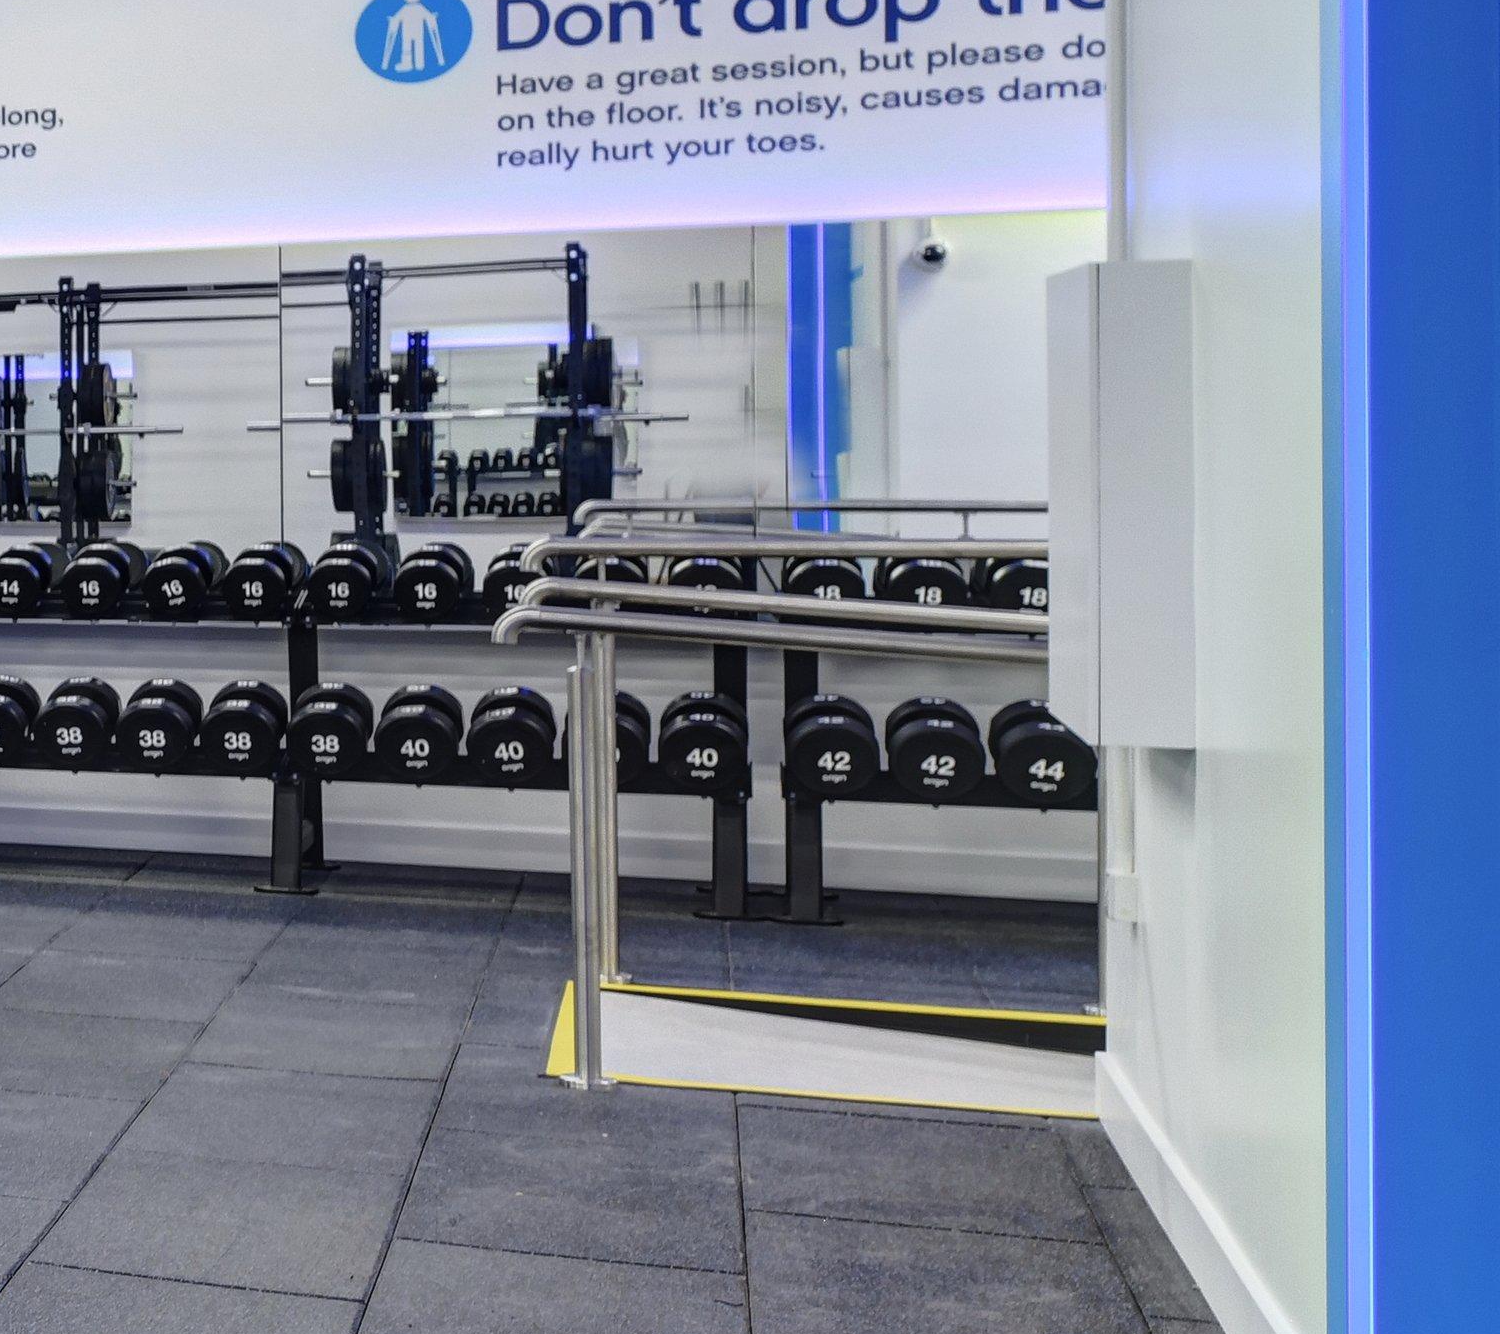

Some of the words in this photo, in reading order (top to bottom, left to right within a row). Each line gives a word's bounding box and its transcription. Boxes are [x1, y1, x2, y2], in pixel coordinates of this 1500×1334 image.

[496, 73, 574, 96] Have
[585, 72, 605, 91] a
[615, 62, 700, 96] great
[711, 53, 847, 83] session,
[859, 47, 915, 73] but
[927, 42, 1045, 76] please
[497, 113, 535, 132] on
[545, 104, 596, 129] the
[606, 100, 683, 125] floor.
[699, 96, 743, 120] It's
[755, 91, 848, 120] noisy,
[860, 85, 985, 111] causes
[997, 76, 1107, 103] dama
[497, 141, 580, 172] really
[591, 138, 654, 163] hurt
[664, 138, 735, 166] your
[745, 133, 825, 155] toes.
[241, 581, 264, 598] 16
[504, 583, 526, 601] 16
[1019, 586, 1048, 607] 18
[55, 726, 83, 746] 38
[138, 729, 166, 748] 38
[224, 731, 252, 751] 38
[311, 734, 340, 754] 38
[400, 738, 430, 758] 40
[494, 741, 525, 762] 40
[685, 747, 719, 768] 40
[817, 751, 852, 772] 42
[920, 754, 956, 777] 42
[1028, 758, 1065, 782] 44
